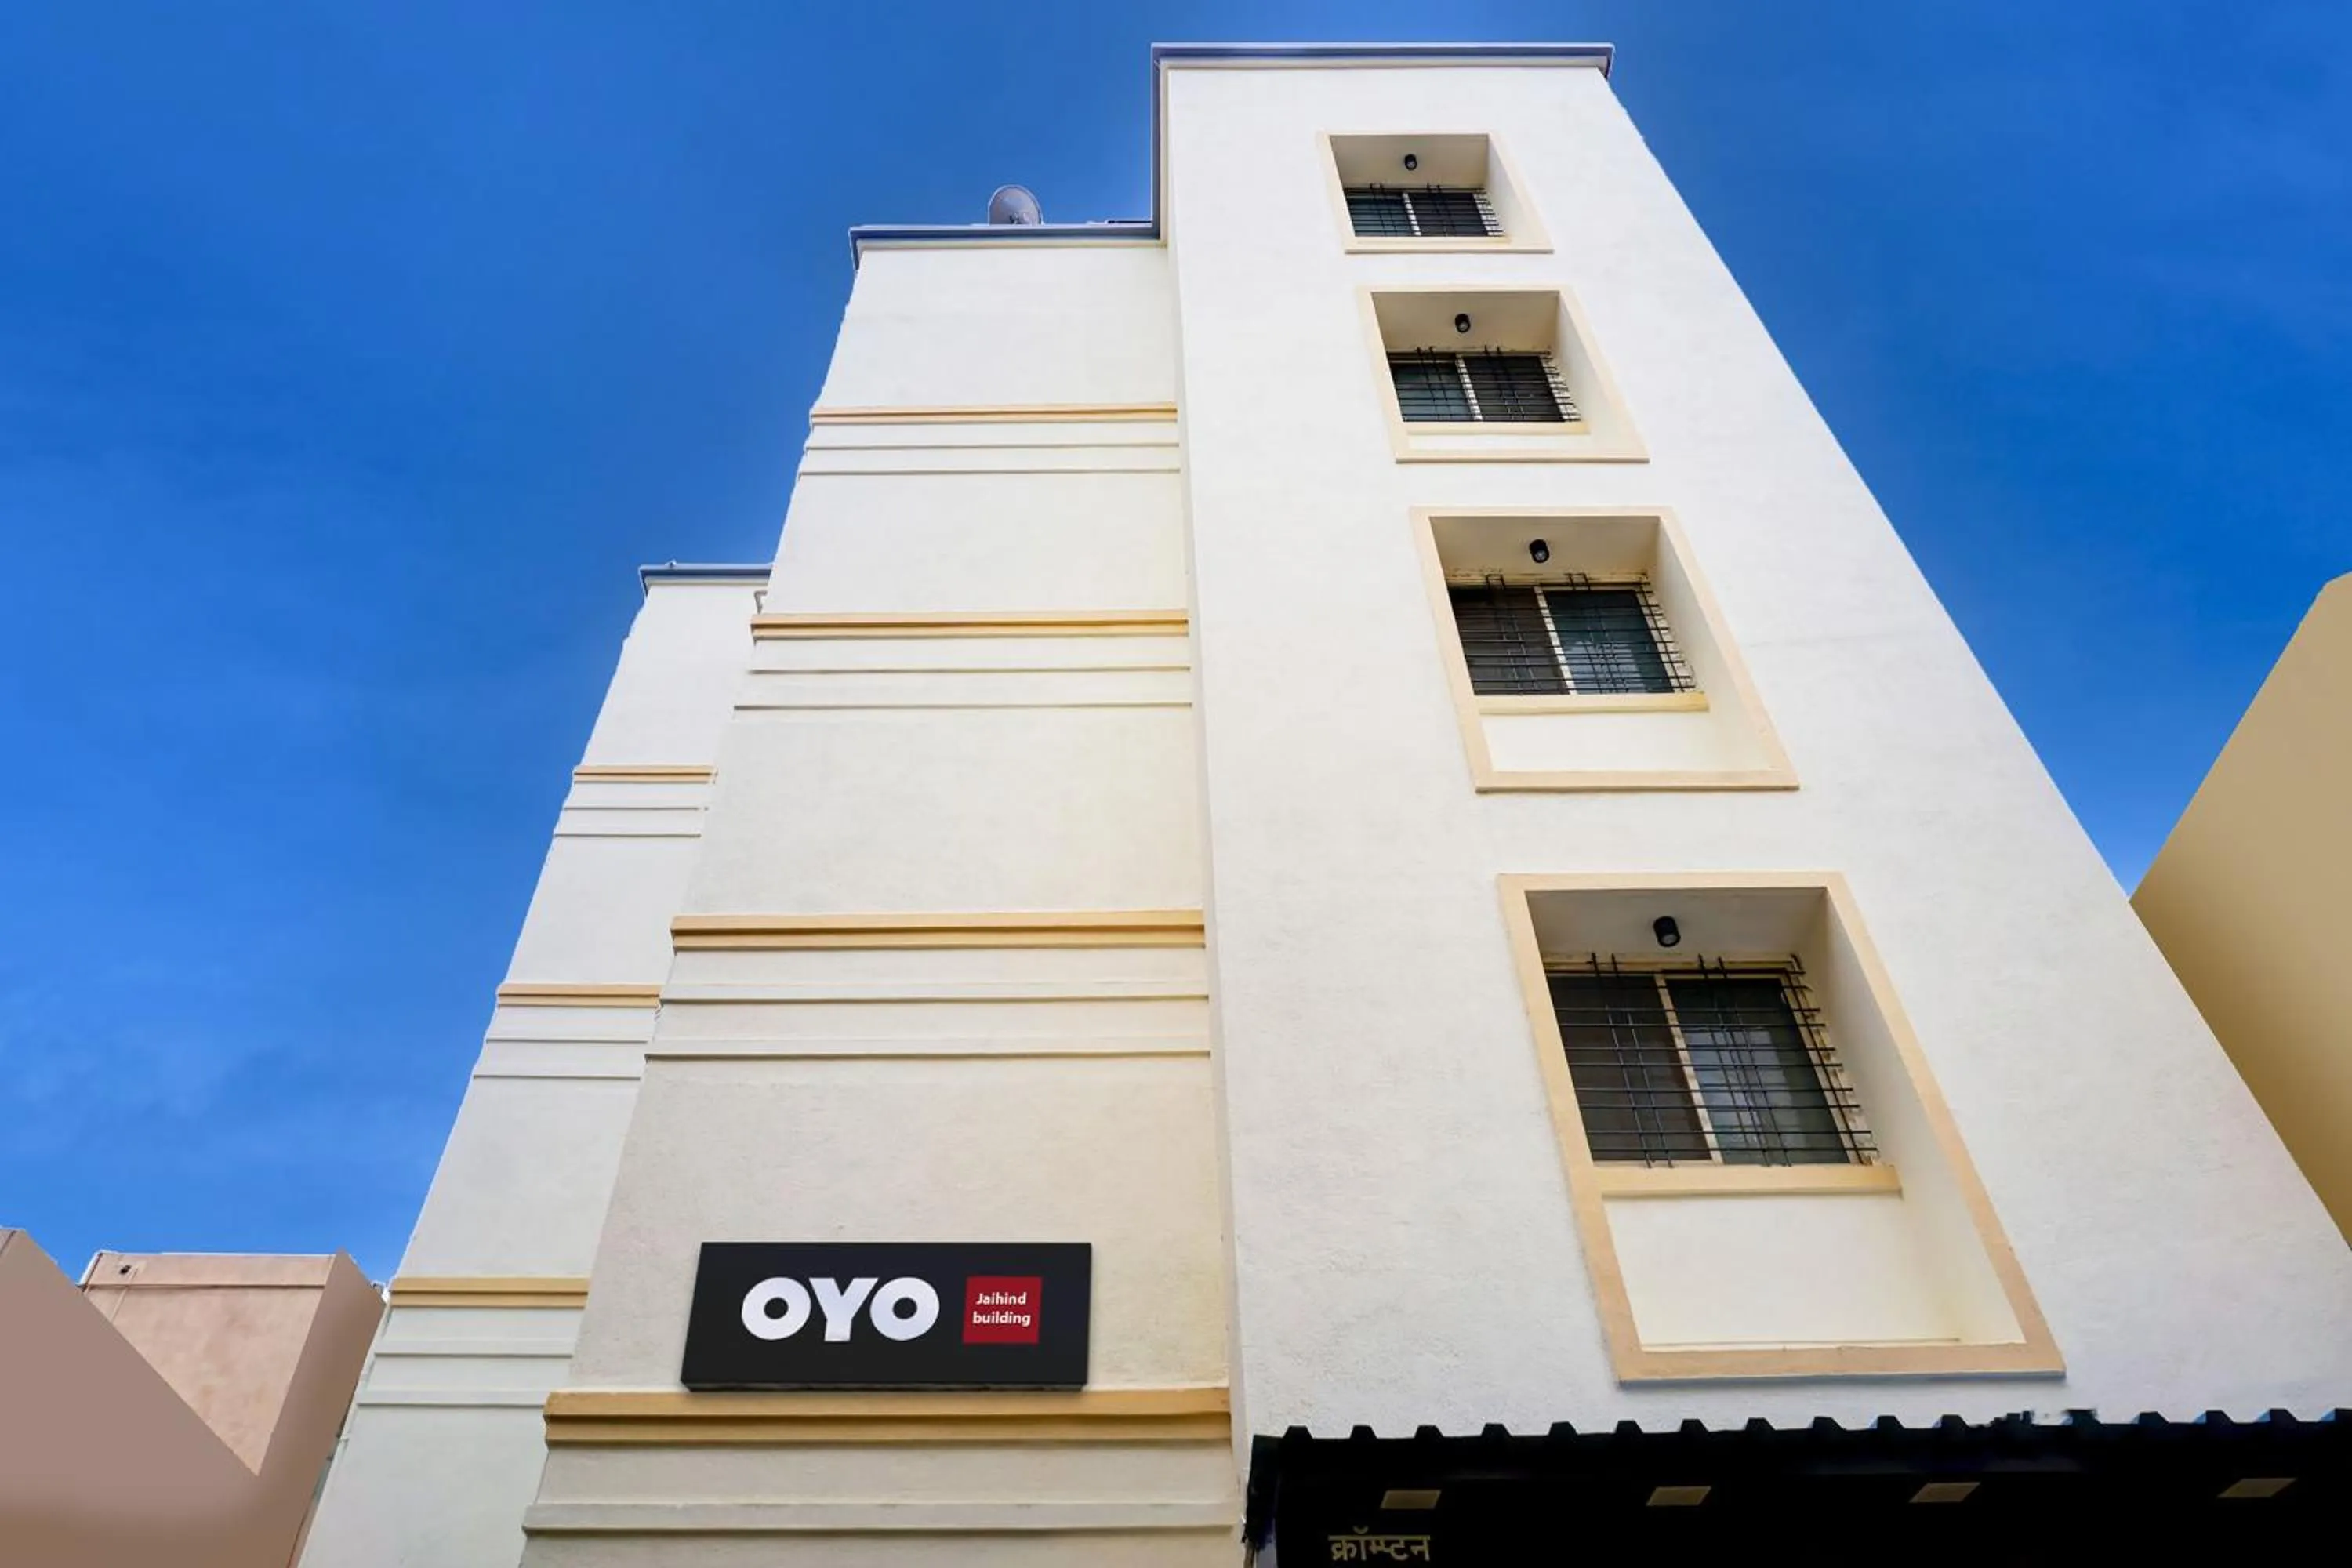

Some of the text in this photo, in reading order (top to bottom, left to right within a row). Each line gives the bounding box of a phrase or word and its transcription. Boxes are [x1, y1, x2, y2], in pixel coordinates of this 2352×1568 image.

[975, 1291, 1027, 1305] Jaihind
[741, 1276, 940, 1341] OYO
[972, 1311, 1031, 1327] building
